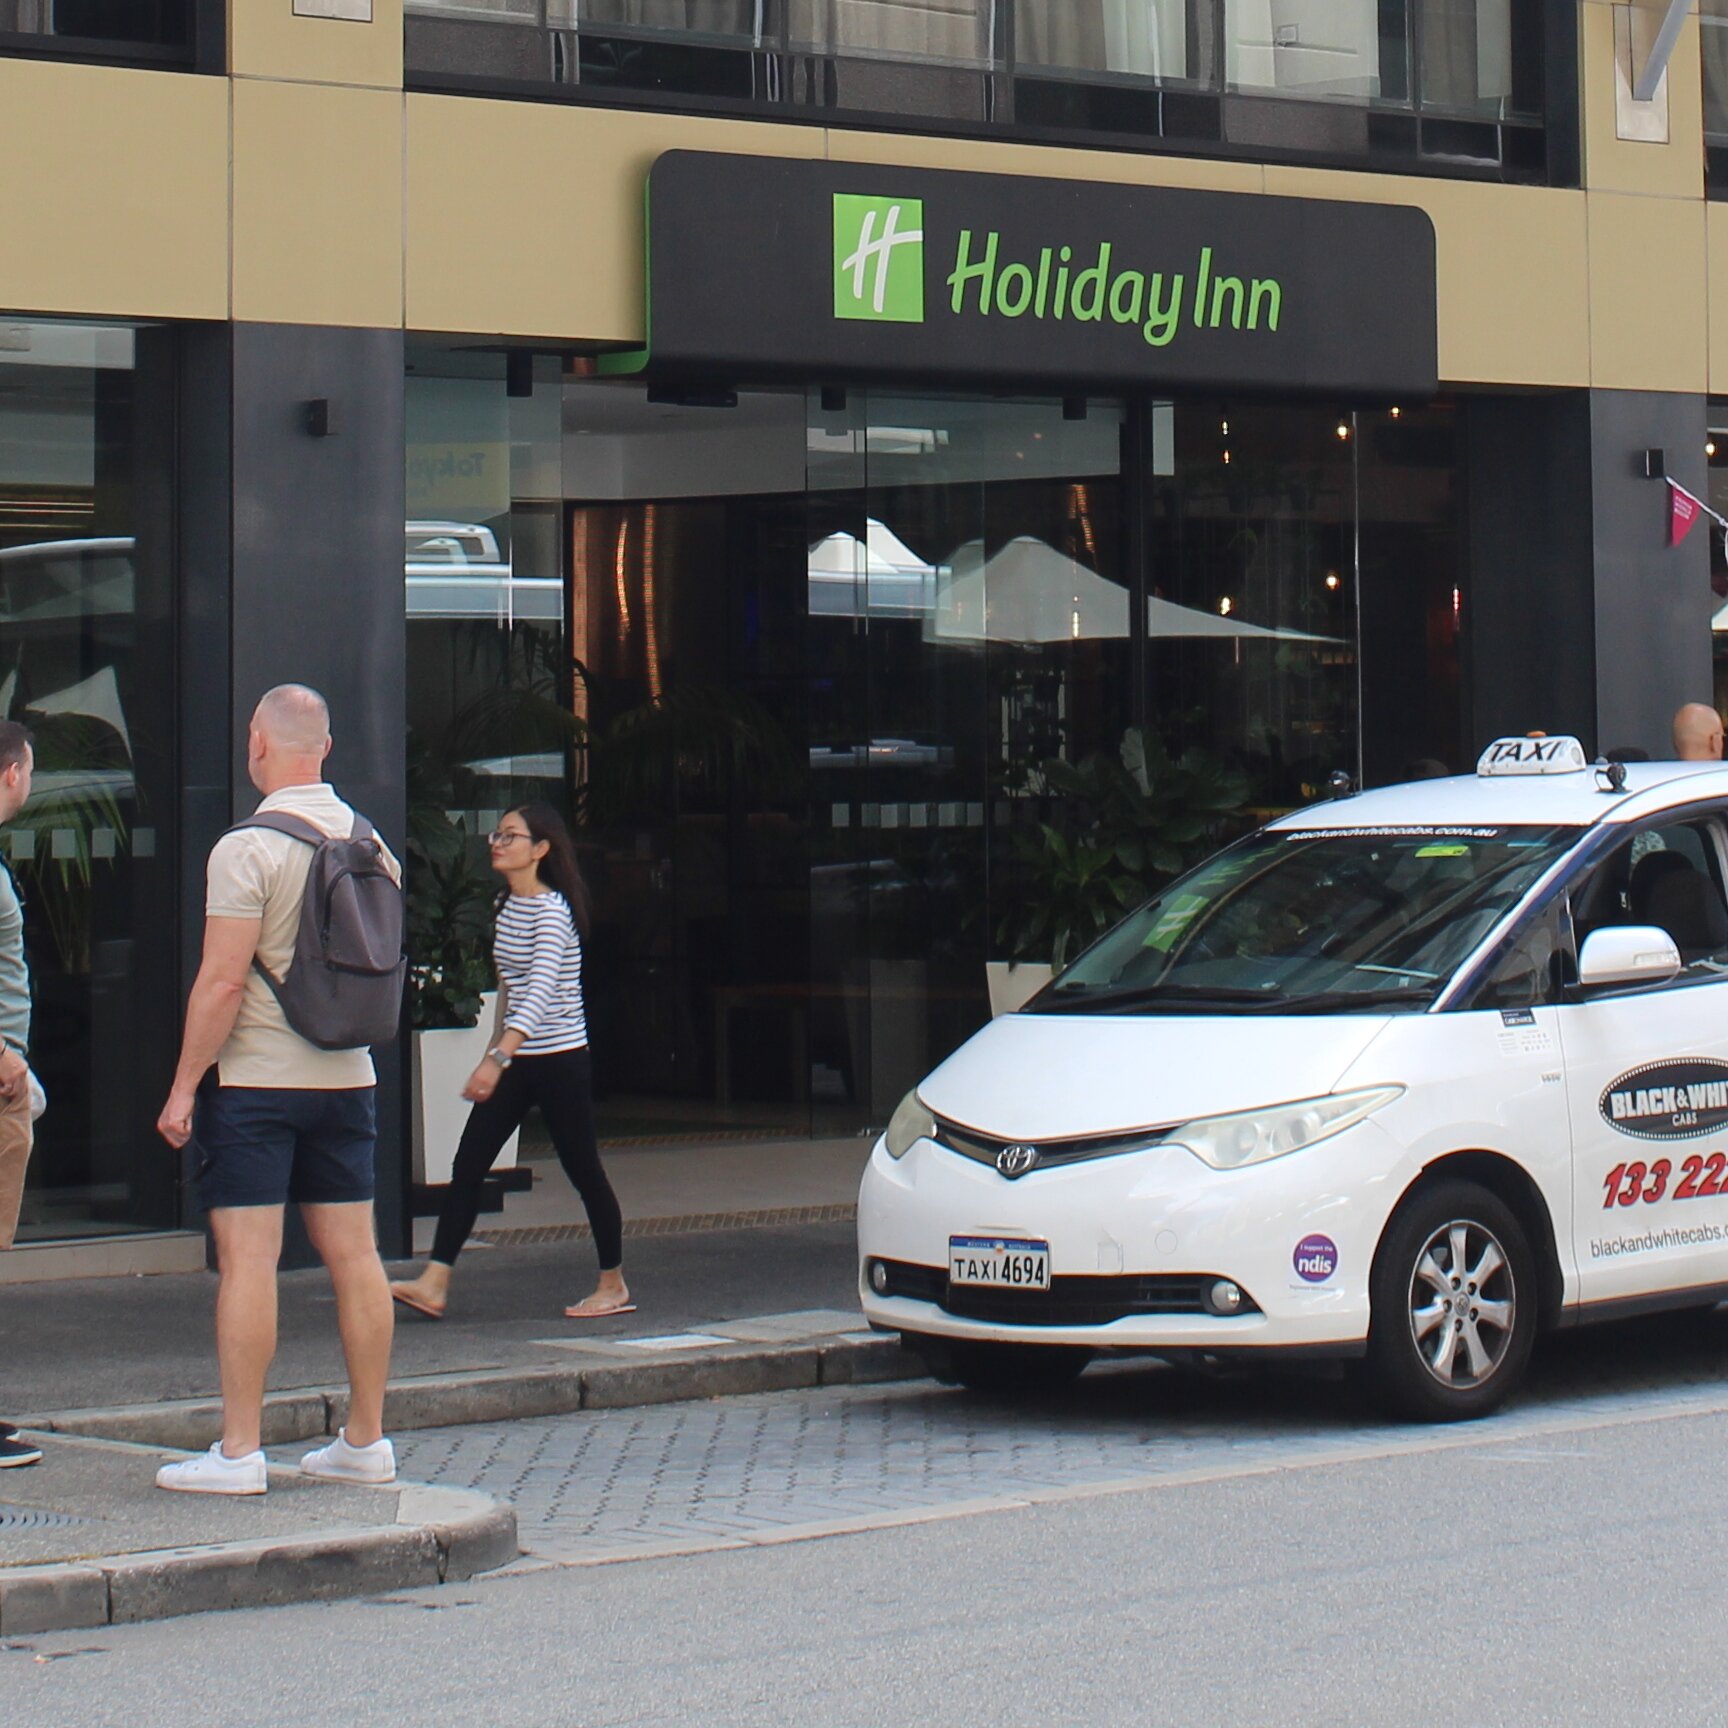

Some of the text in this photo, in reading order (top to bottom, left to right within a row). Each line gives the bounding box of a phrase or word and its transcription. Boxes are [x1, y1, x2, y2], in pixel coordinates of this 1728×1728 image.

[947, 229, 1282, 347] Holiday Inn
[1490, 742, 1561, 762] TAXI
[1672, 1112, 1698, 1127] CABS
[1602, 1158, 1672, 1210] 133
[1298, 1254, 1332, 1274] ndis
